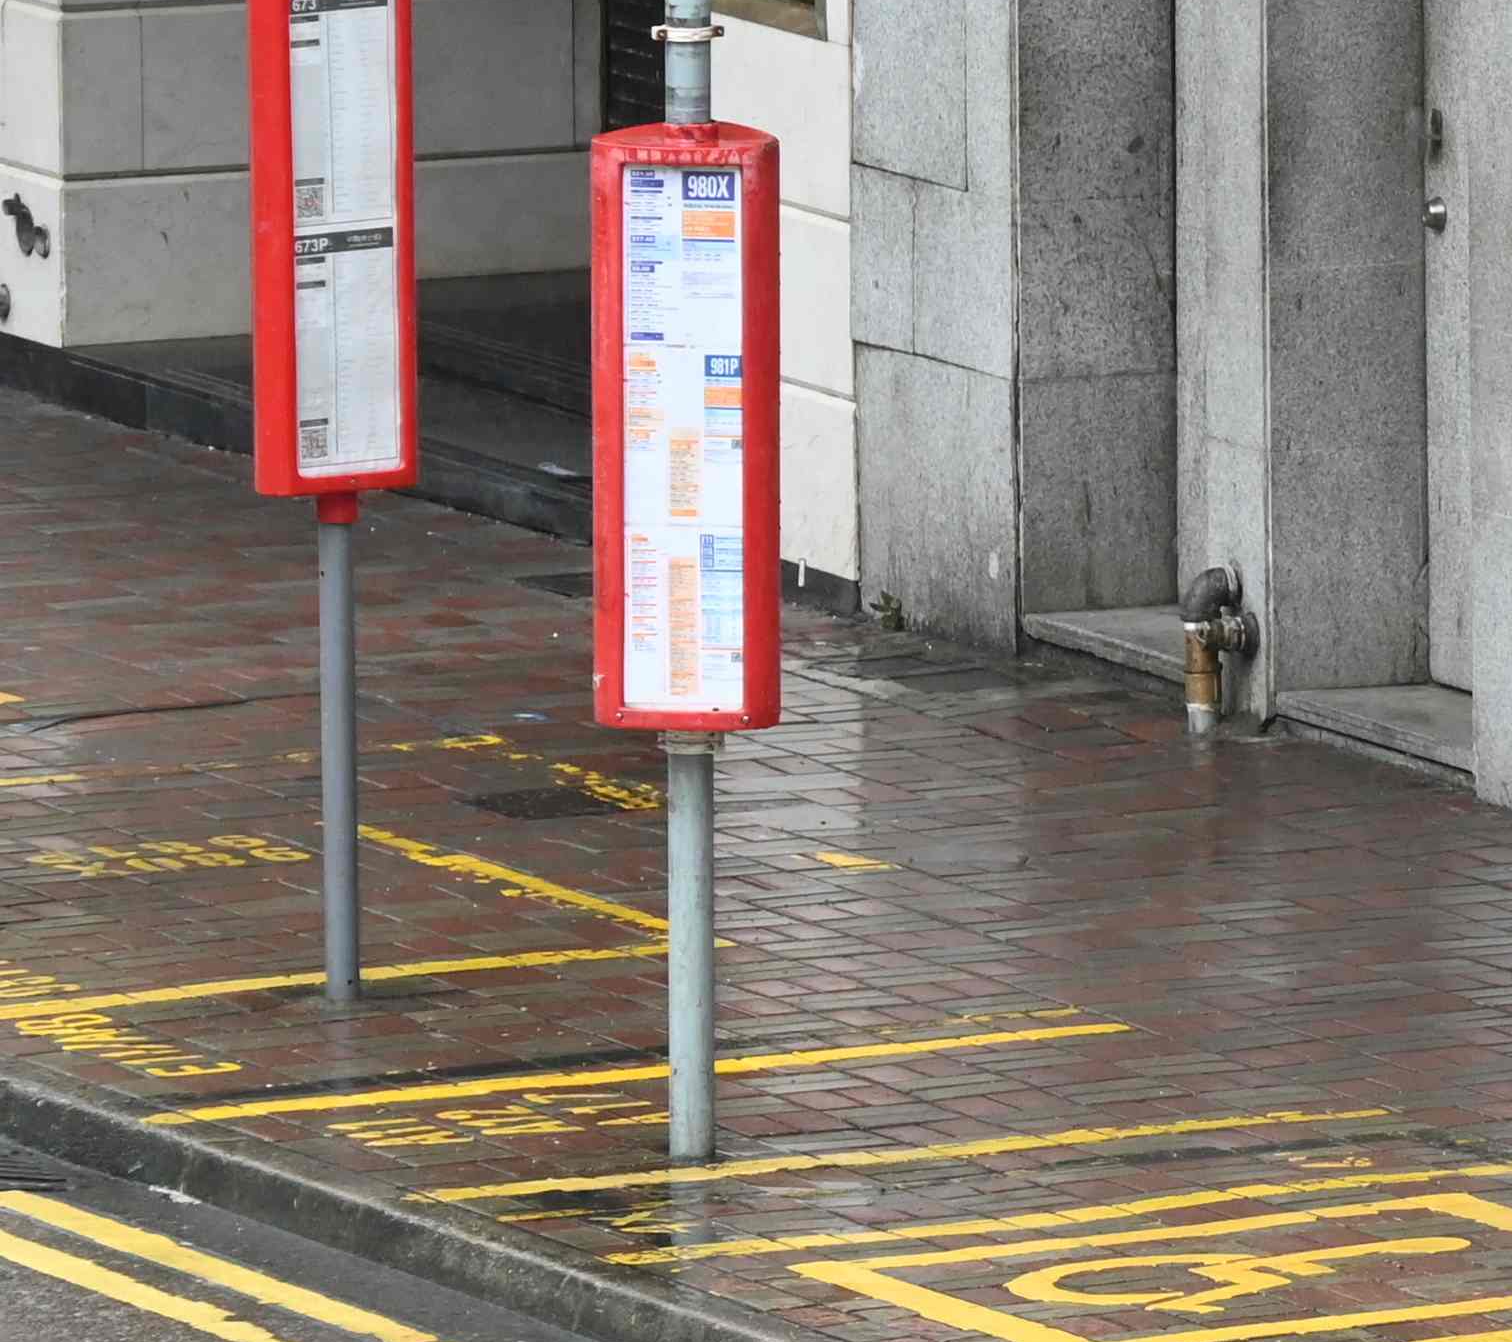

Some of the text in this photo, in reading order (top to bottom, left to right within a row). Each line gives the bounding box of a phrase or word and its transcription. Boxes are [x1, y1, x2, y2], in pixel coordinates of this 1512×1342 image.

[687, 174, 729, 199] 980X
[294, 237, 330, 254] 673P
[710, 356, 739, 376] 981P
